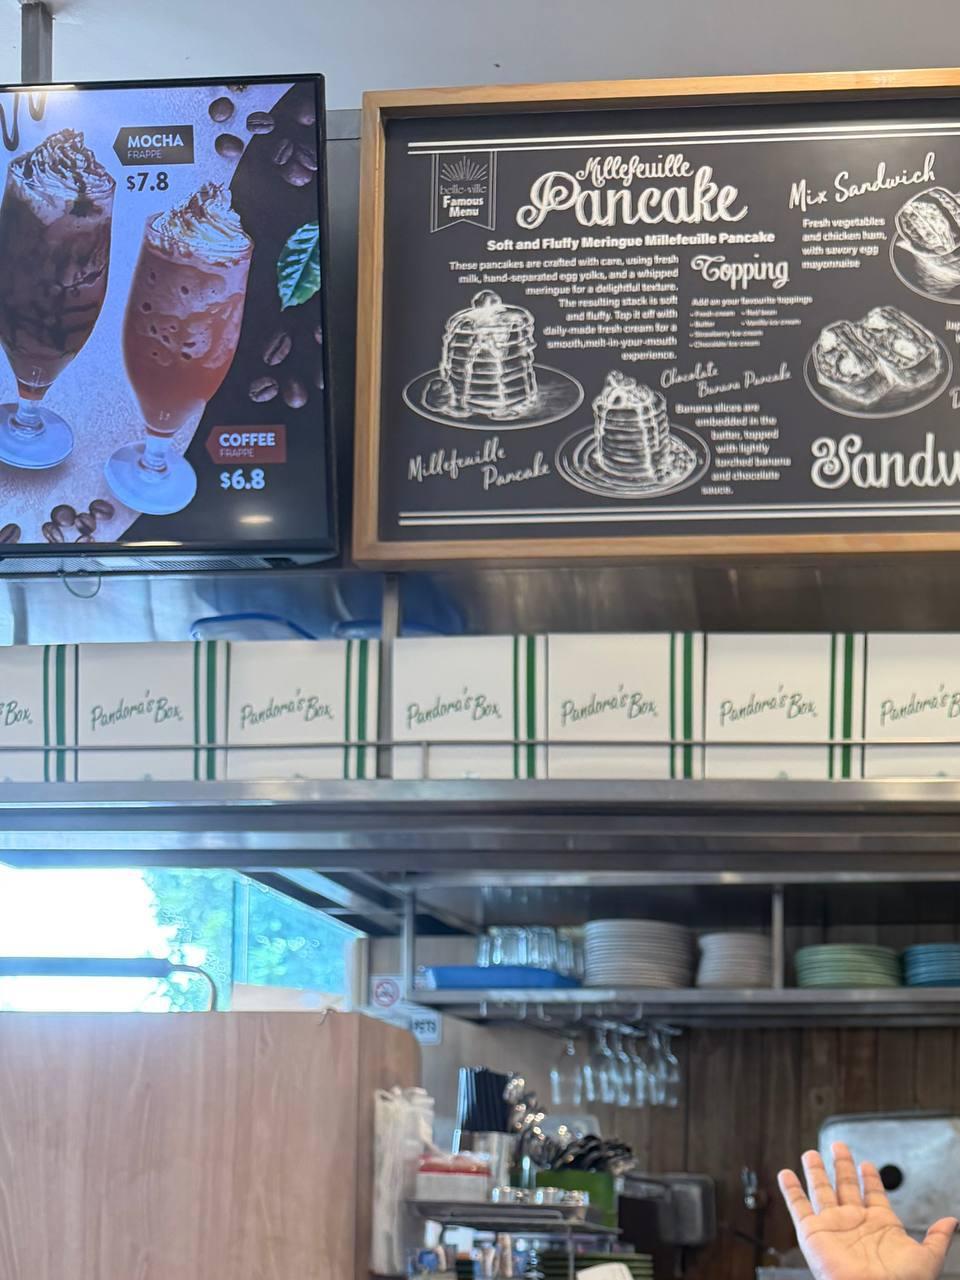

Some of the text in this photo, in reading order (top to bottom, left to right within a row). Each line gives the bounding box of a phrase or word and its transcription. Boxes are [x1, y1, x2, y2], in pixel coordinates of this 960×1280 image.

[127, 132, 184, 149] MOCHA
[127, 149, 163, 160] FRAPPE
[576, 153, 694, 187] Millefeuille
[126, 172, 169, 192] $7.8
[440, 184, 487, 195] belle-ville
[788, 152, 936, 212] Mix Sandwich
[443, 195, 484, 208] Famous
[516, 165, 748, 229] Pancake
[448, 206, 479, 217] Menu
[802, 216, 885, 229] Fresh vegetables
[487, 231, 774, 251] Soft and Fluffy Meringue Millefeuille Pancake
[802, 232, 822, 241] and
[822, 231, 861, 241] chicken
[801, 246, 879, 256] with savory egg
[450, 261, 478, 270] These
[478, 259, 524, 270] pancakes
[525, 260, 542, 268] are
[542, 257, 577, 267] crafted
[577, 257, 599, 266] with
[625, 255, 653, 267] using
[653, 254, 679, 264] fresh
[690, 253, 790, 290] Topping
[801, 259, 860, 271] mayonnaise
[743, 362, 791, 389] Pancake
[219, 432, 276, 447] COFFEE
[219, 448, 254, 458] FRAPPE
[408, 437, 506, 482] Millefeuille
[219, 469, 265, 490] $6.8
[483, 452, 550, 490] Pancake
[91, 688, 154, 732] Pandora's
[241, 688, 305, 730] Pandora's
[407, 686, 473, 730] Pandora's
[561, 684, 628, 728] Pandora's
[720, 684, 788, 728] Pandora's
[880, 684, 949, 728] Pandora's
